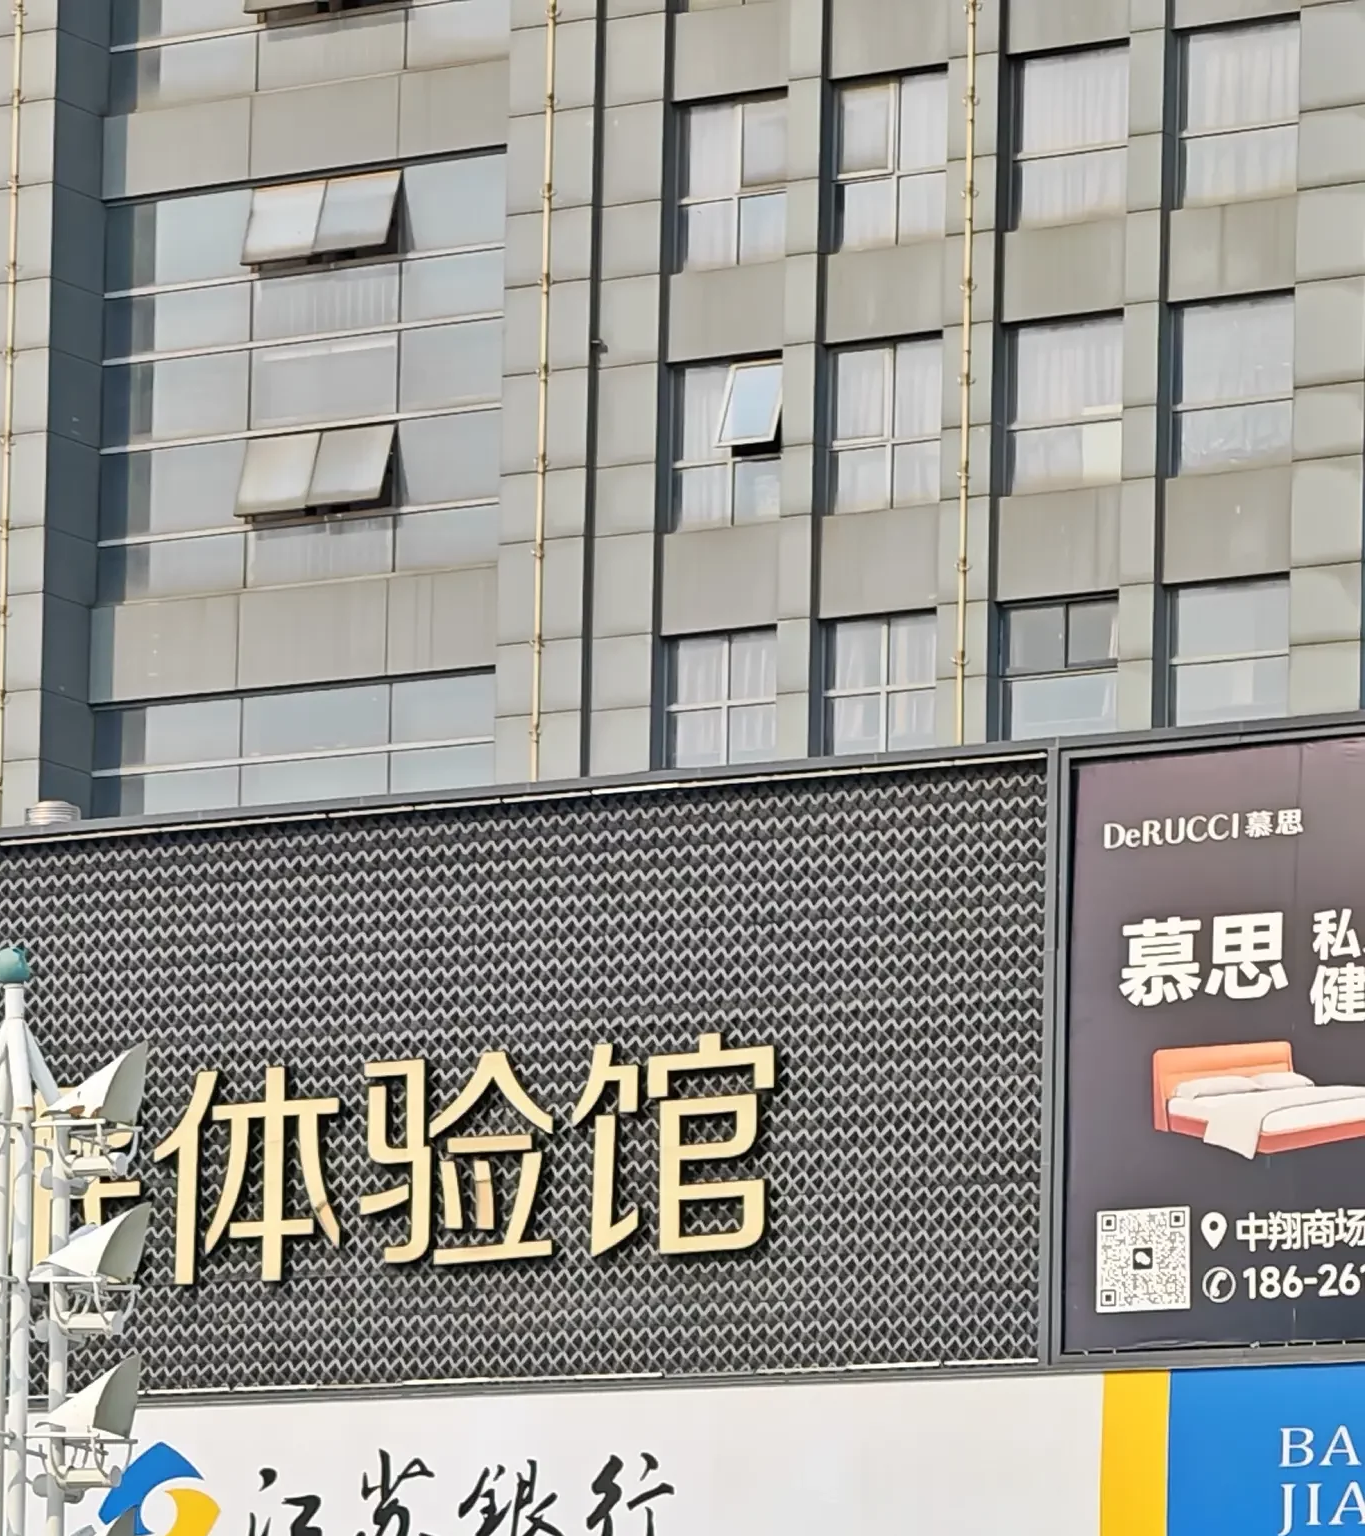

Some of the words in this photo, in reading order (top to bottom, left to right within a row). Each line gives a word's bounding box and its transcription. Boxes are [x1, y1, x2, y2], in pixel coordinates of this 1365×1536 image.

[1103, 812, 1240, 850] DeRUCCI
[1244, 808, 1304, 838] 慕思
[1118, 911, 1290, 1007] 慕思
[1312, 908, 1365, 961] 私
[1235, 1207, 1365, 1253] 中翔商场
